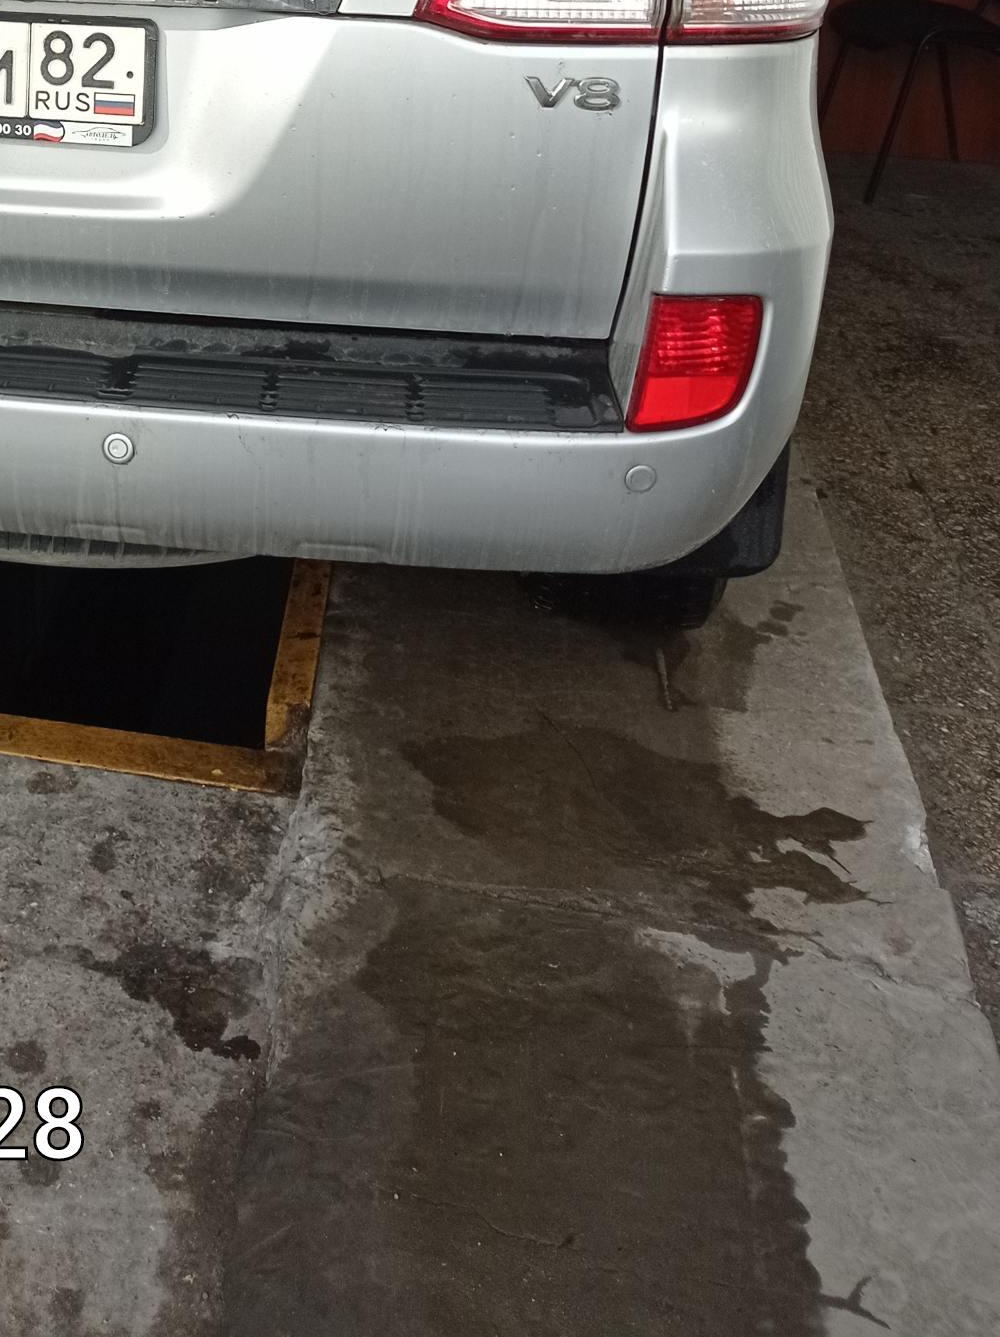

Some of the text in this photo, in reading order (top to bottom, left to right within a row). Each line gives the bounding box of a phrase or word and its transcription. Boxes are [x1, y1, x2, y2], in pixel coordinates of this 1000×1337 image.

[38, 29, 116, 89] 82
[34, 89, 91, 113] RUS
[523, 75, 621, 112] V8
[15, 125, 32, 137] 30
